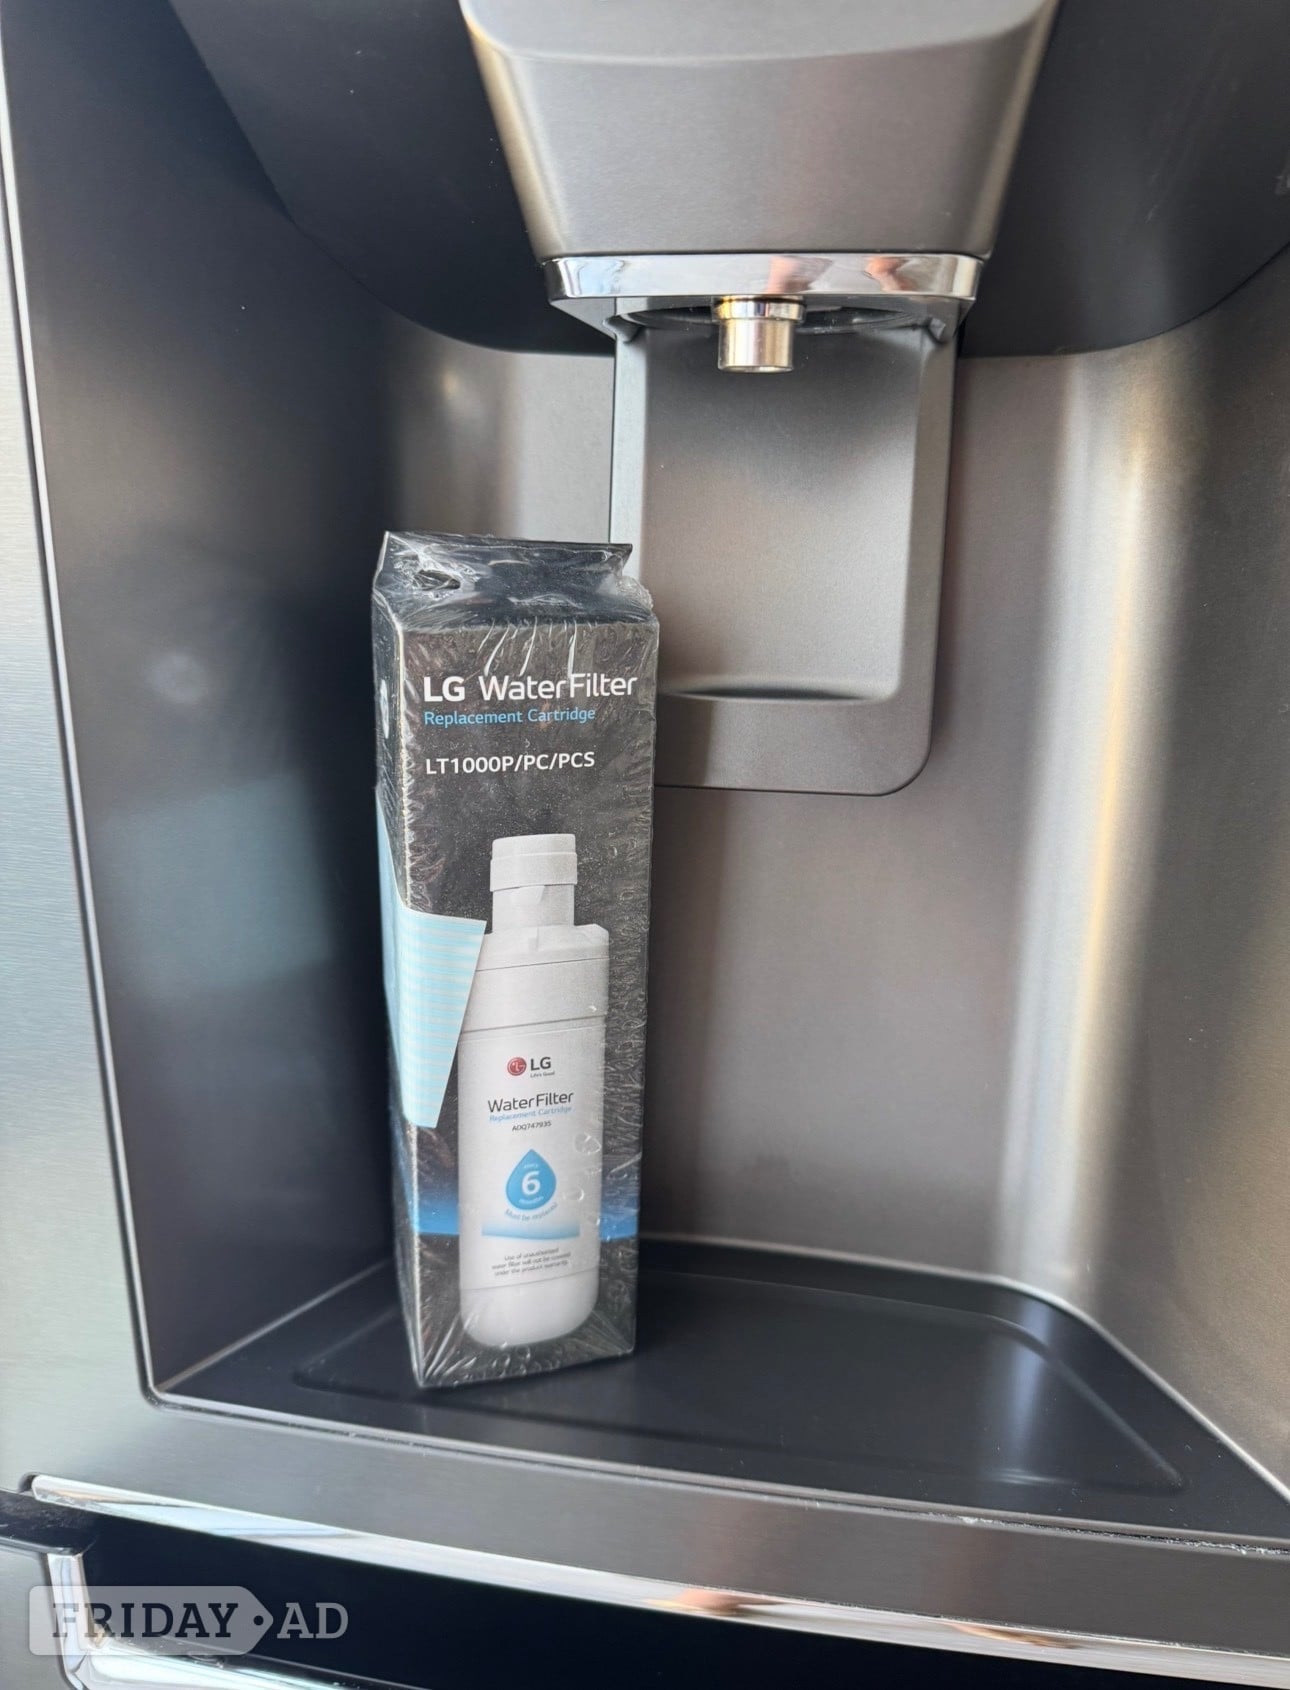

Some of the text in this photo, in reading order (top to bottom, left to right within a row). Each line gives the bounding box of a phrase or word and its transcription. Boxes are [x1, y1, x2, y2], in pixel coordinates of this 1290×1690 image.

[423, 676, 465, 702] LG
[424, 707, 596, 729] Replacement Cartridge
[425, 751, 596, 775] LT1000P/PC/PCS
[530, 1056, 552, 1071] LG
[489, 1105, 572, 1122] Replacement Cartridge
[521, 1170, 541, 1195] 6
